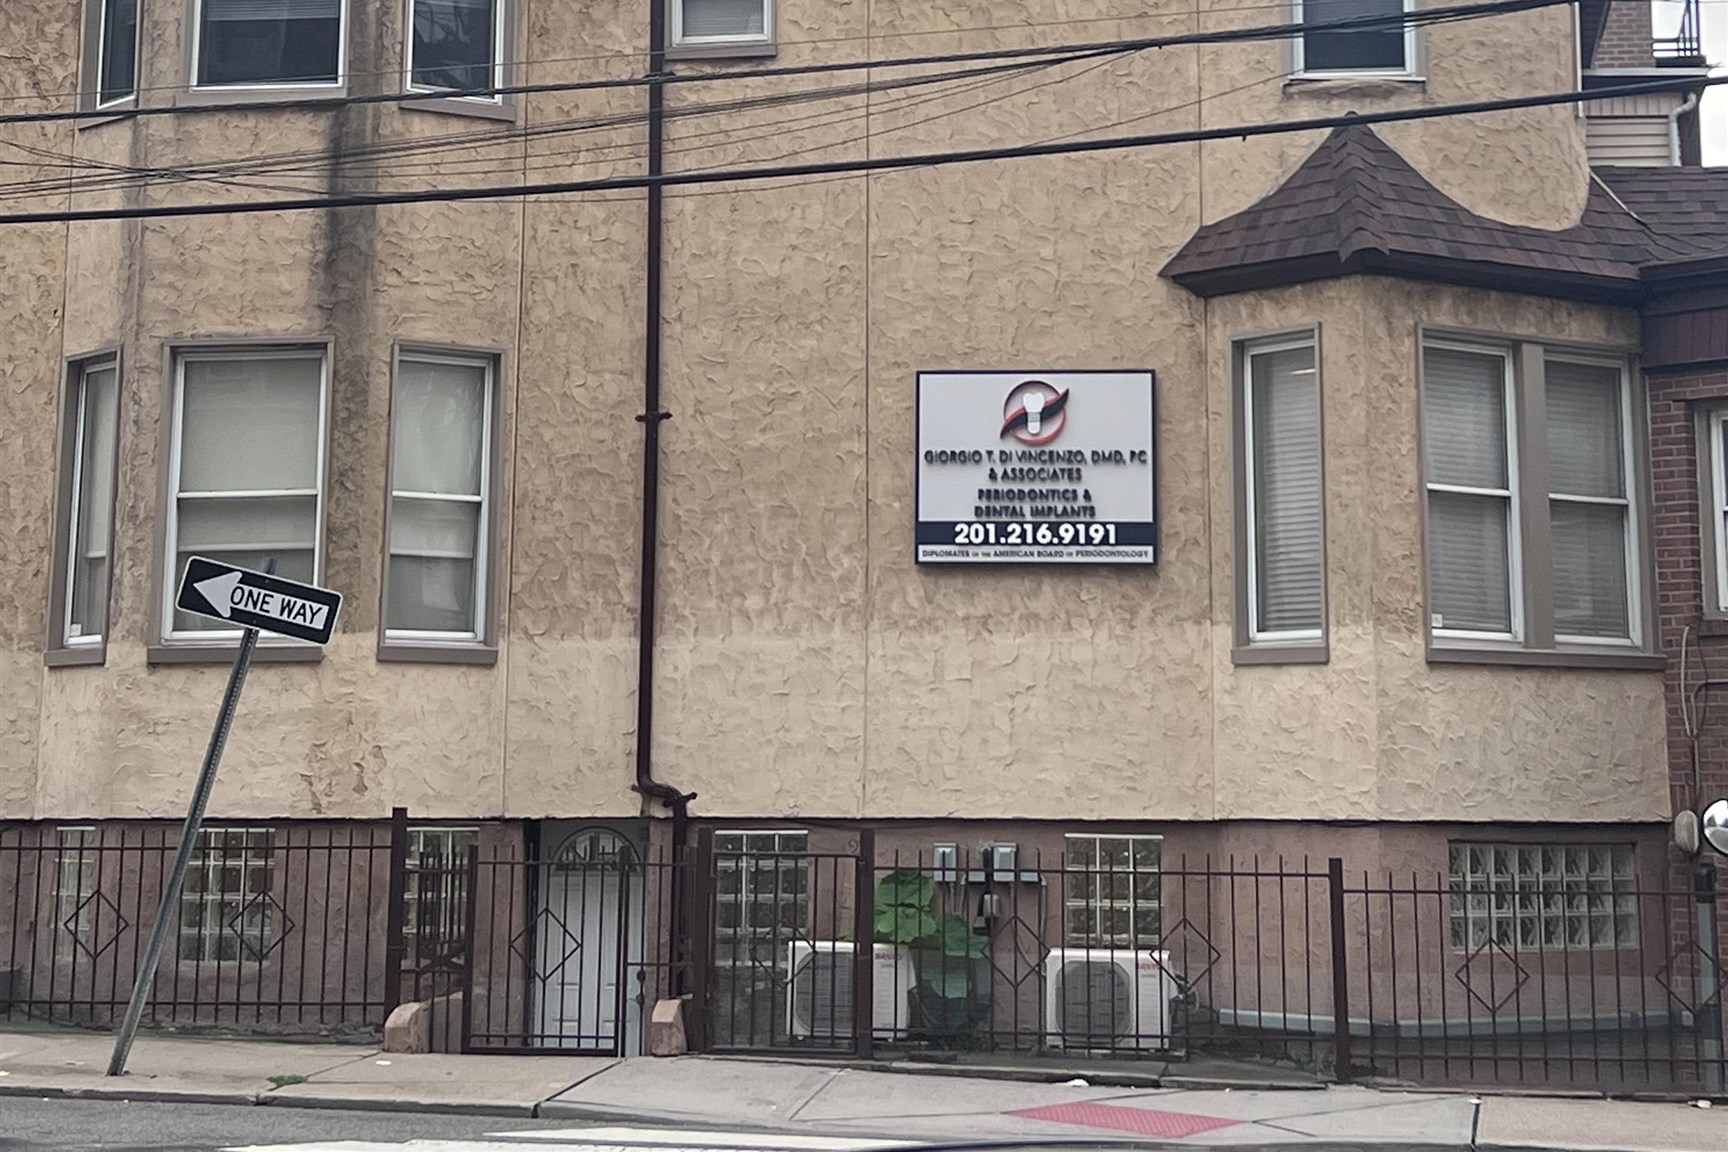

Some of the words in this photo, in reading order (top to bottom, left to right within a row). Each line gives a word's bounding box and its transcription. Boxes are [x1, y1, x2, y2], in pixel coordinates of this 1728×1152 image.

[924, 450, 982, 464] GIORGIO
[999, 450, 1012, 463] DI
[1016, 450, 1087, 465] VINCENZO,
[1091, 450, 1126, 465] DMD,
[1130, 450, 1147, 464] PC
[989, 467, 997, 481] &
[1001, 467, 1081, 481] ASSOCIATES
[978, 489, 1078, 502] PERIODONTICS
[1083, 489, 1092, 502] &
[974, 505, 1025, 518] DENTAL
[1030, 505, 1095, 518] IMPLANTS
[955, 523, 1115, 544] 201.216.9191
[230, 586, 274, 613] ONE
[279, 598, 323, 624] WAY
